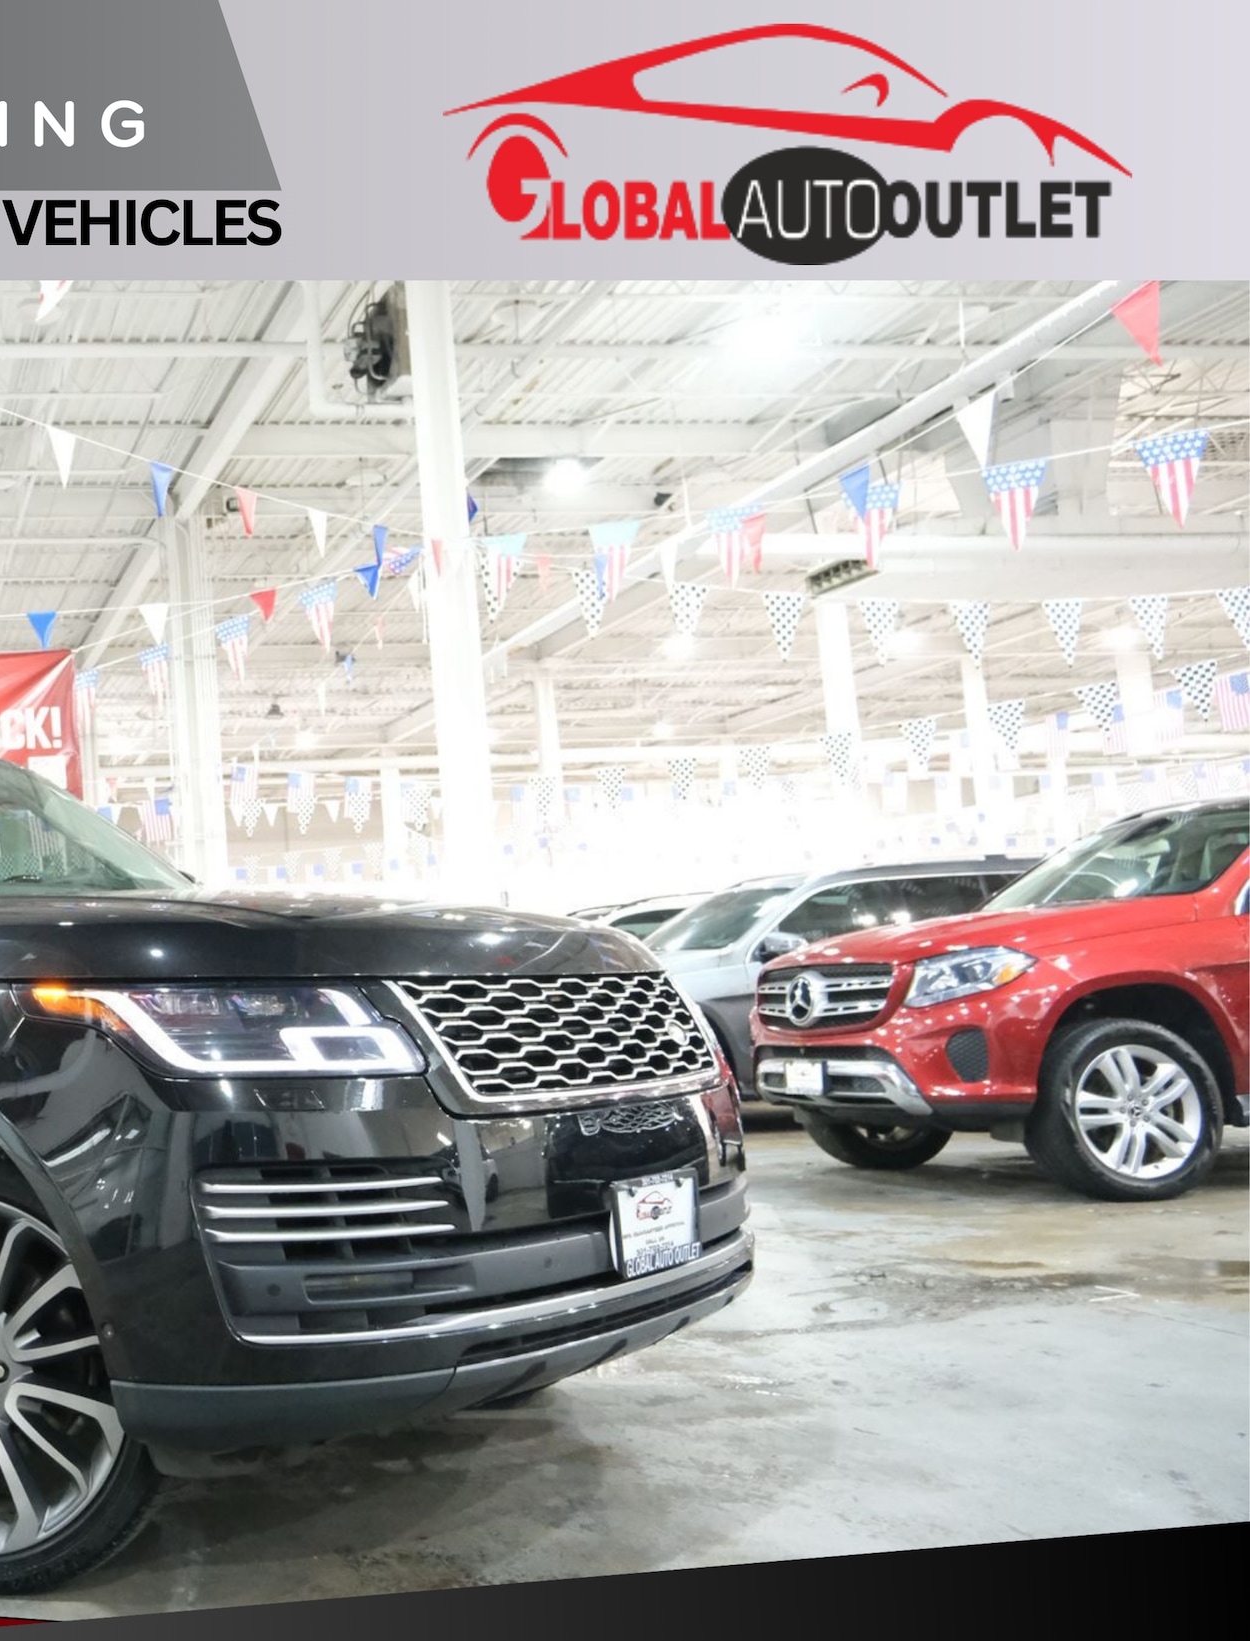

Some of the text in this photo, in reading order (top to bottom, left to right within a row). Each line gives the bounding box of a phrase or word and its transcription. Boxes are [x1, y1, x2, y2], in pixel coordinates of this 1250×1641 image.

[626, 1241, 701, 1279] GLOBAL AUTO OUTLET
